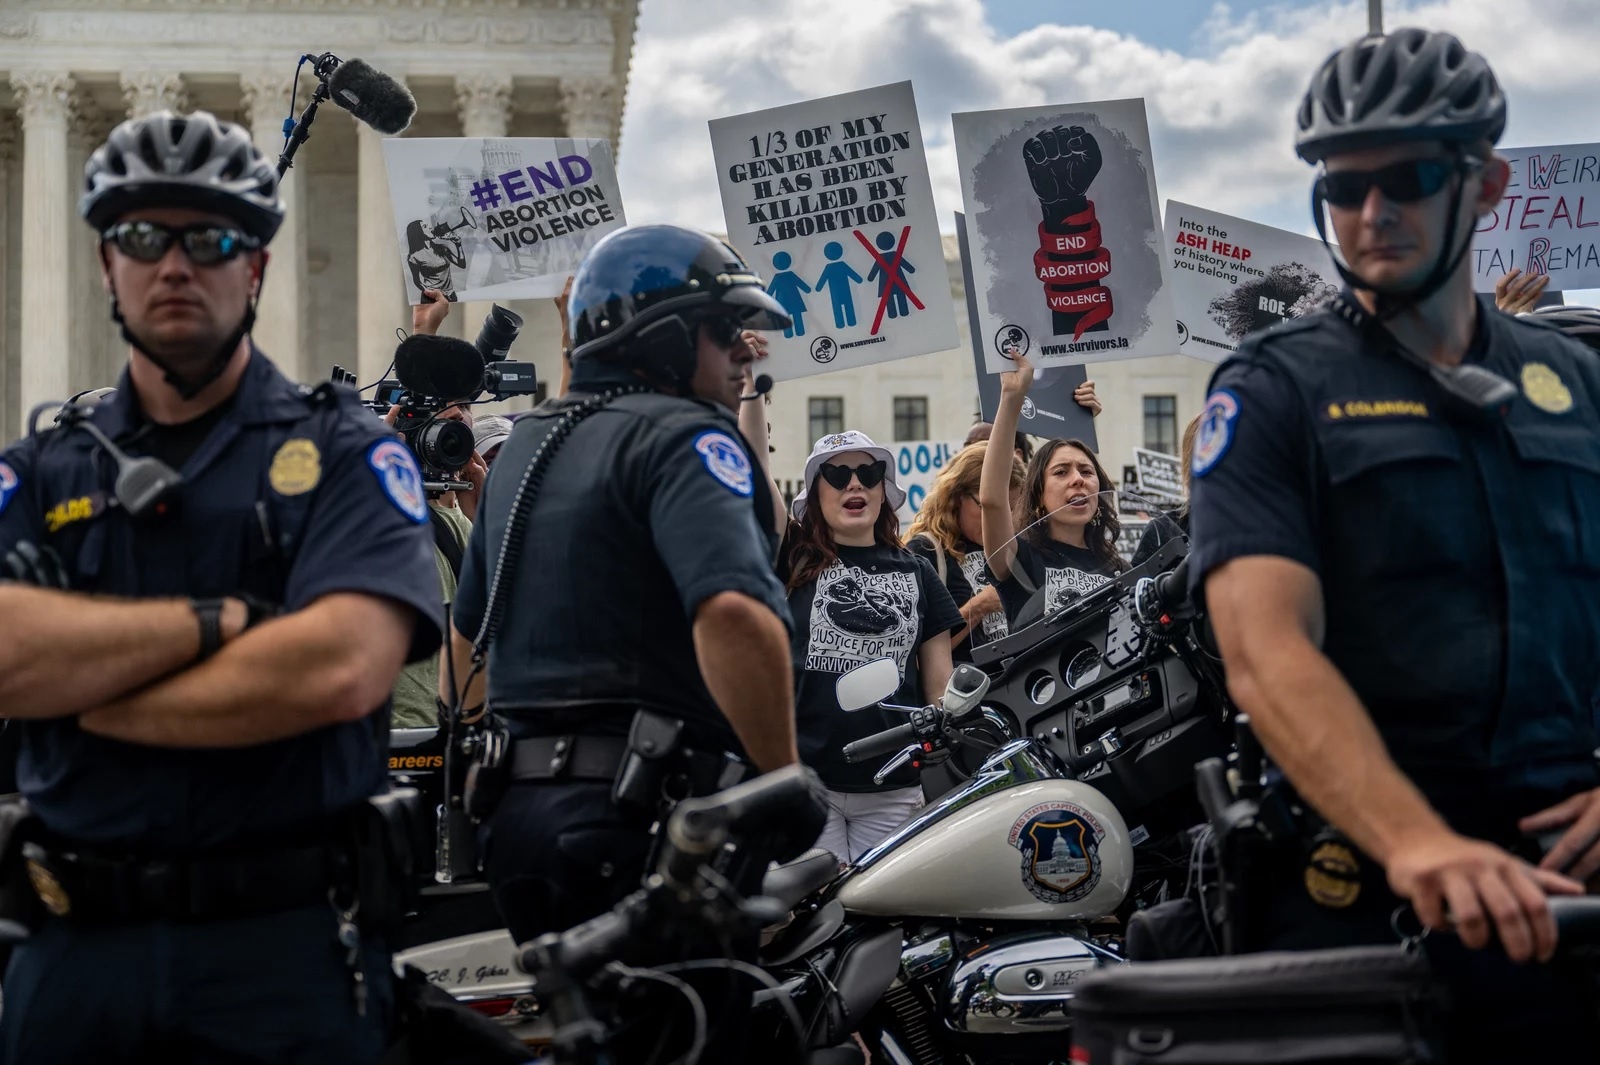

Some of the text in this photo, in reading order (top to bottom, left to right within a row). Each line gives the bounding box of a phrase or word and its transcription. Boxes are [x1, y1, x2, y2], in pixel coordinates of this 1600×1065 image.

[749, 114, 887, 159] 1/3 OF MY
[728, 131, 911, 183] GENERATION
[1528, 153, 1600, 190] WEIR
[469, 154, 593, 212] #END
[752, 156, 895, 200] HAS BEEN
[486, 184, 605, 234] ABORTION
[746, 176, 908, 224] KILLED BY
[491, 204, 615, 253] VIOLENCE
[753, 198, 906, 246] ABORTION
[1179, 217, 1228, 239] Into the
[1056, 236, 1086, 251] END
[1176, 231, 1252, 261] ASH HEAP
[1039, 261, 1110, 279] ABORTION
[1173, 258, 1238, 284] you belong
[1174, 246, 1265, 278] of history where
[1050, 292, 1107, 307] VIOLENCE
[1258, 295, 1286, 316] ROE
[1041, 337, 1128, 356] www.survivors.la
[819, 569, 846, 581] NOT
[812, 629, 905, 656] JUSTICE FOR THE
[1010, 803, 1103, 843] UNITED STATES CAPITOL POLICE
